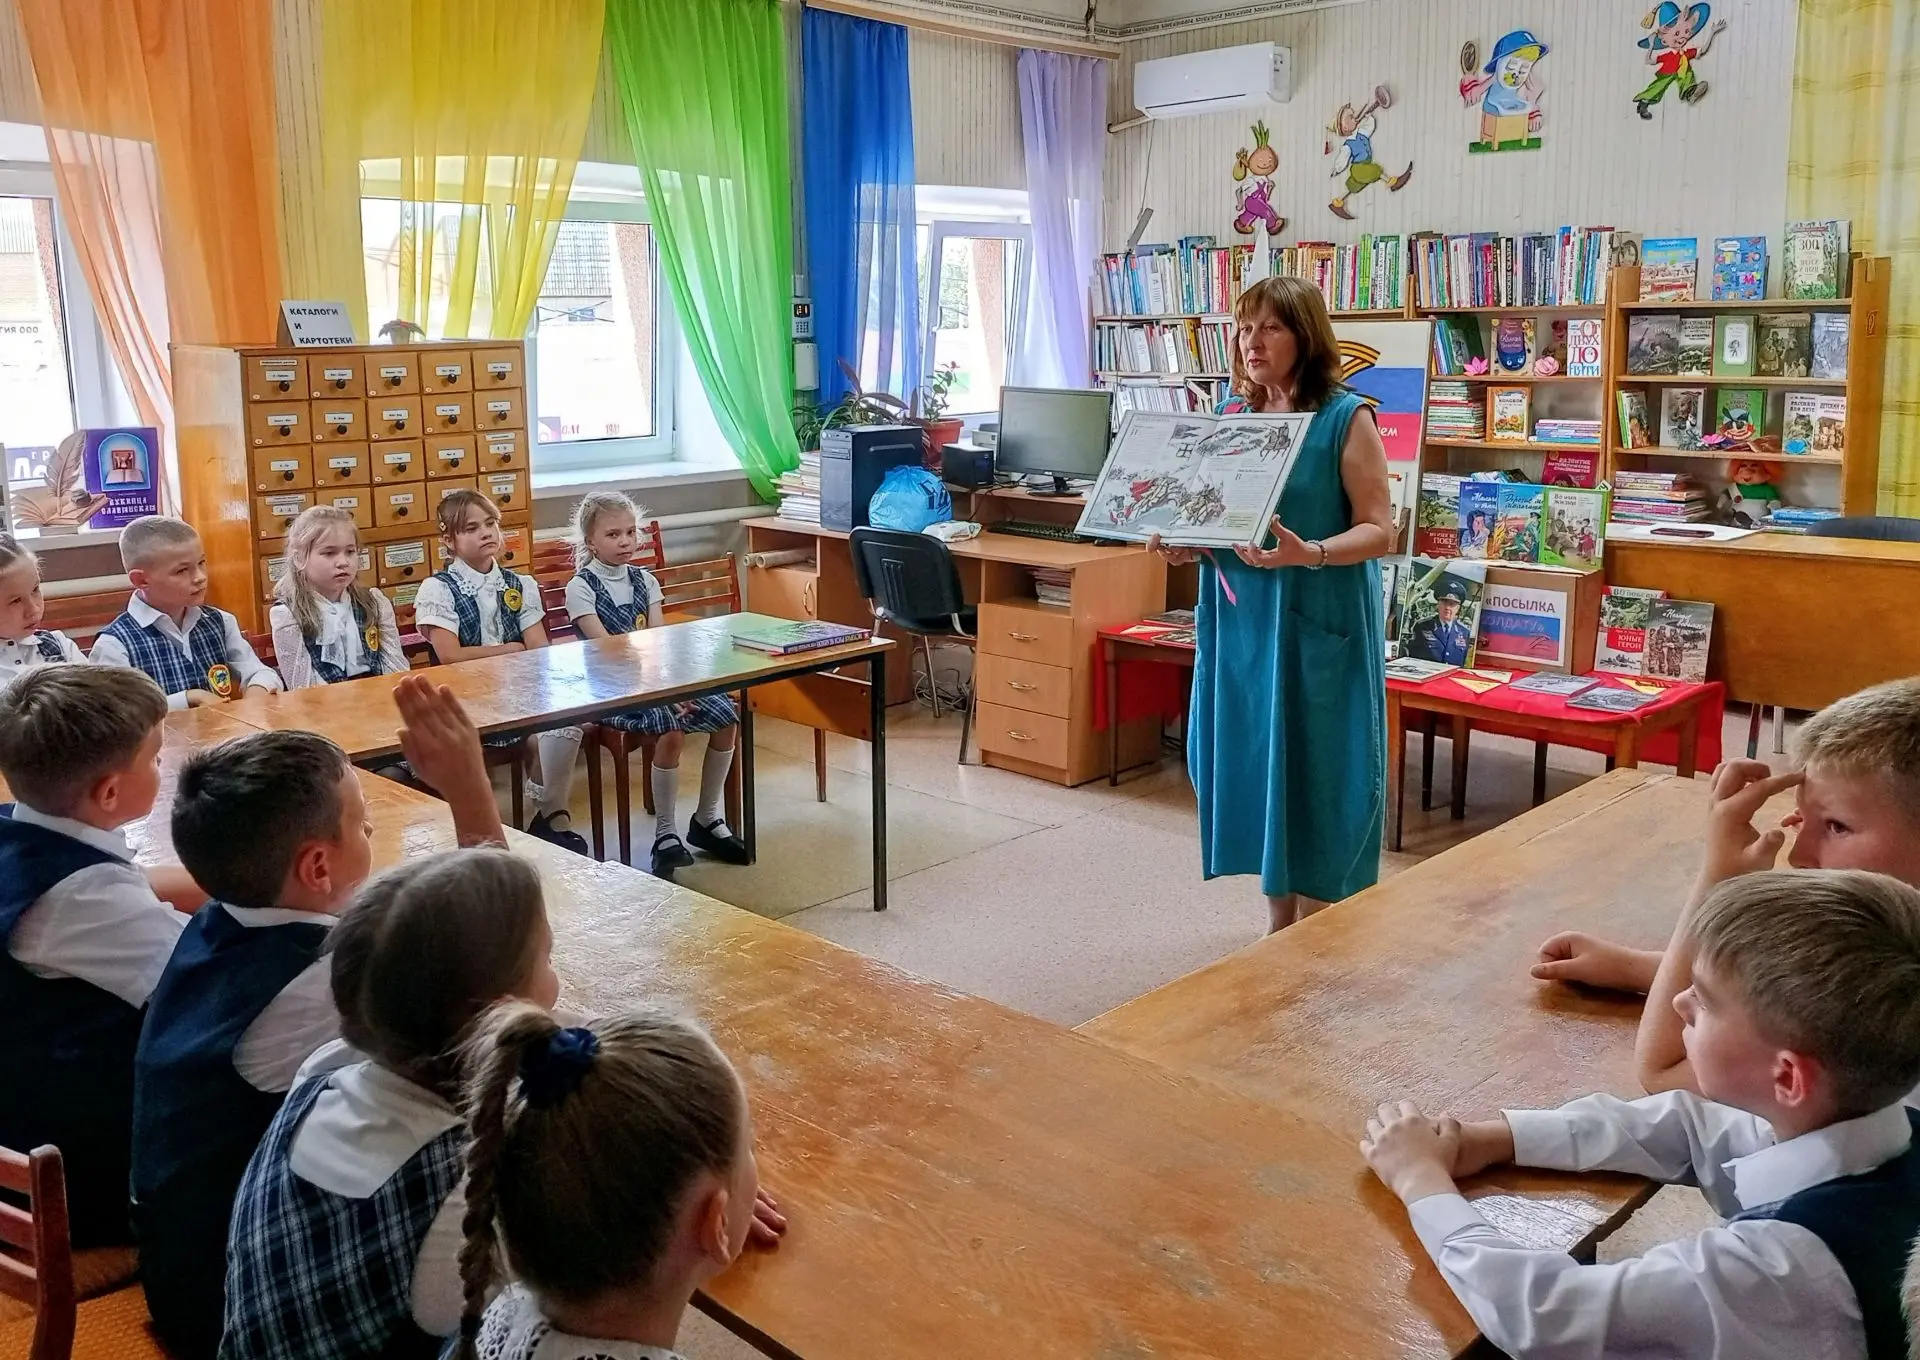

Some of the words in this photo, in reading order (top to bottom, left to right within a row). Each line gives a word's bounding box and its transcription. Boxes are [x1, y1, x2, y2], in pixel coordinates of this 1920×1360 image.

[289, 308, 339, 316] КАТАЛОГИ
[294, 322, 302, 330] И
[299, 337, 353, 345] КАРТОТЕКИ
[1569, 334, 1600, 348] ДВУХ
[1570, 346, 1599, 365] ДО
[1378, 426, 1399, 438] ем
[1485, 596, 1556, 613] «ПОСЫЛКА
[1618, 634, 1643, 643] ЮНЫЕ
[1617, 641, 1642, 650] ГЕРОИ
